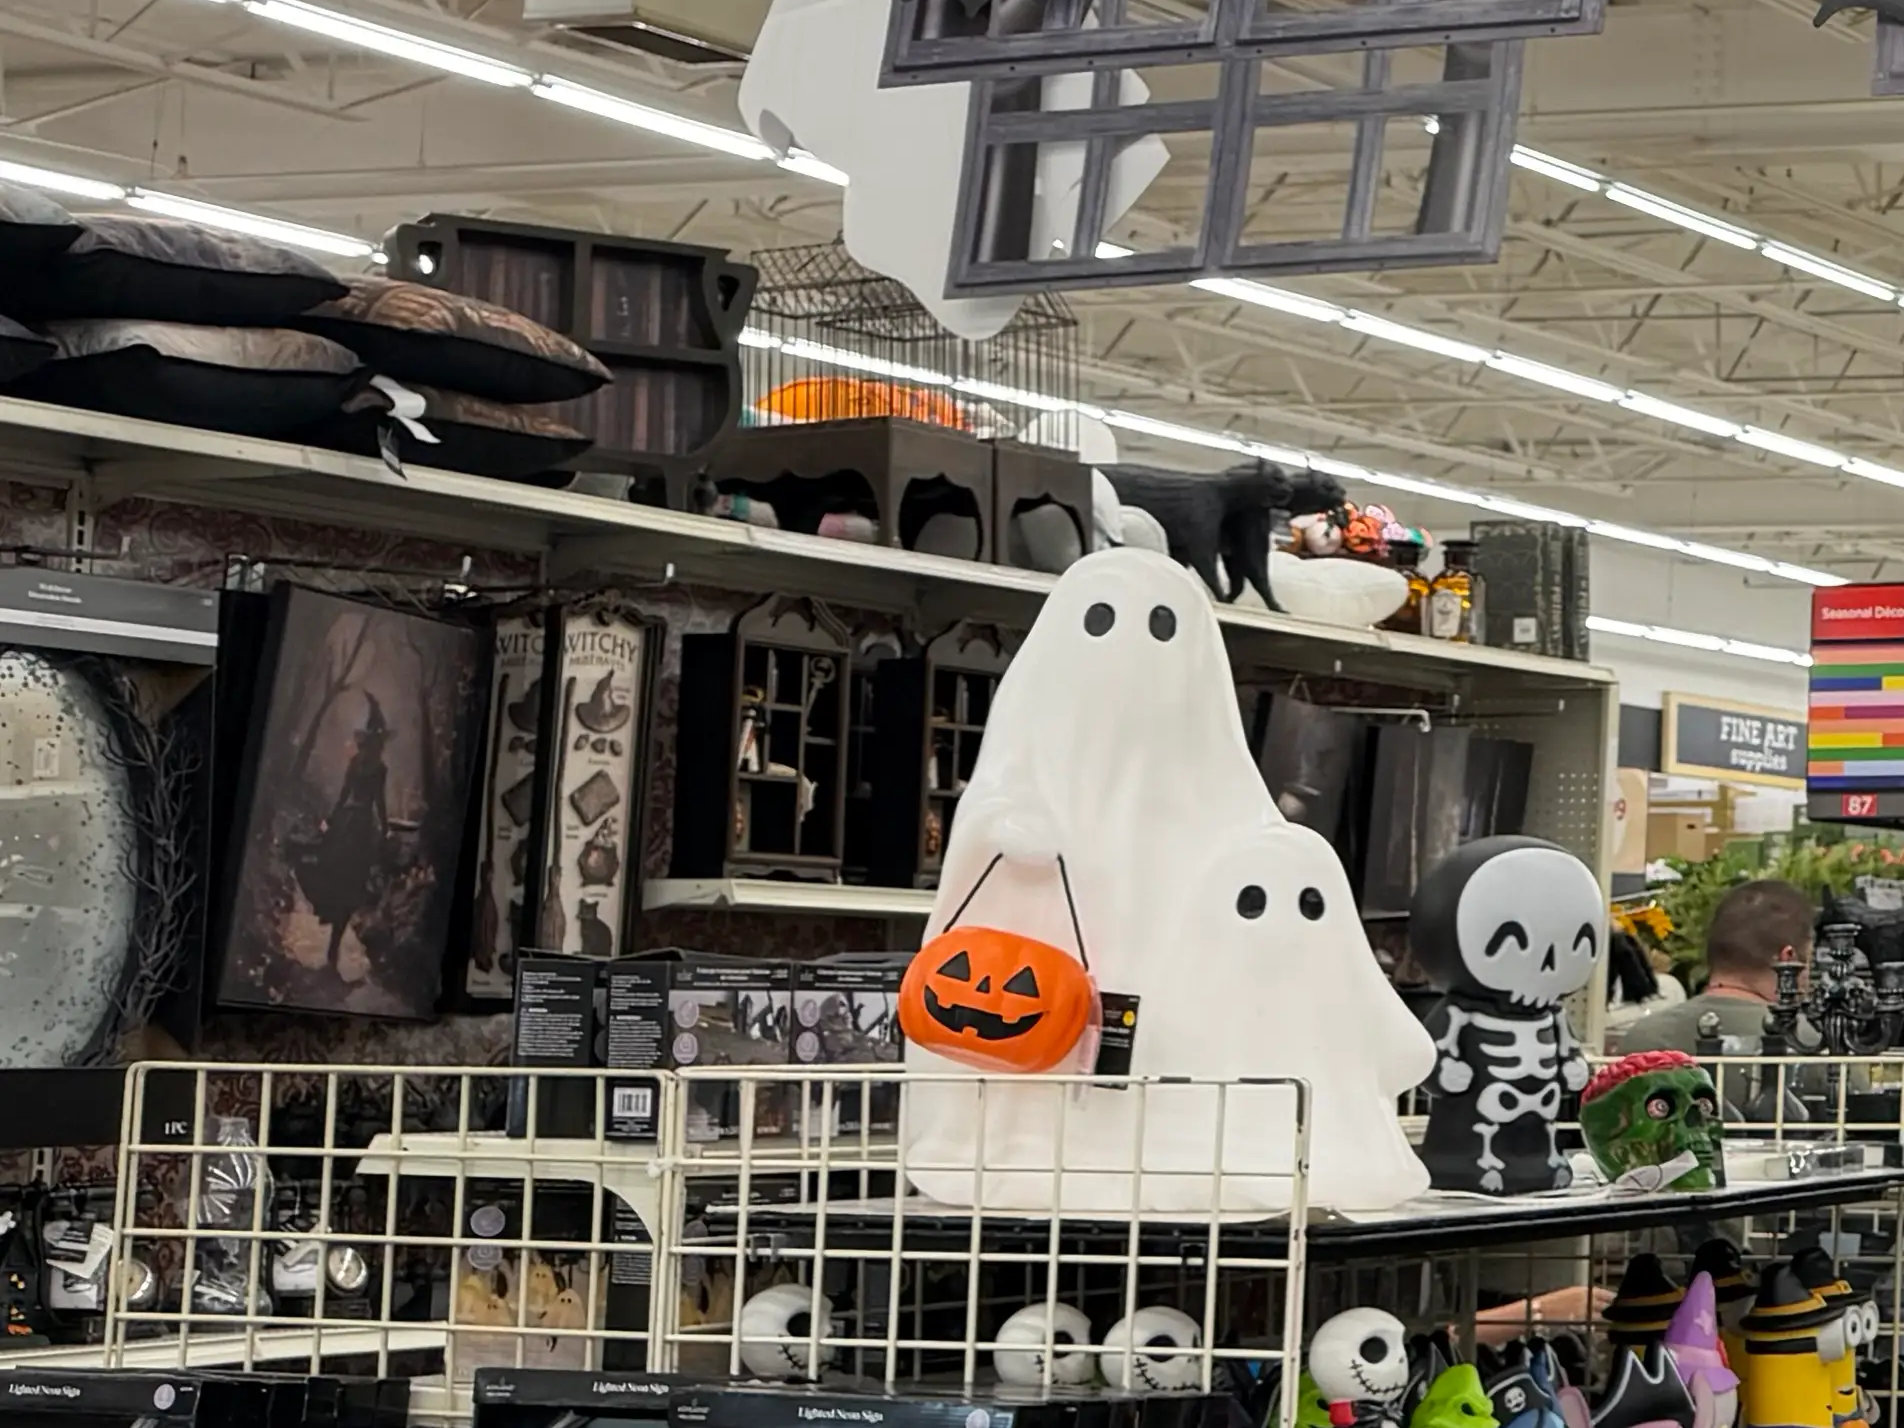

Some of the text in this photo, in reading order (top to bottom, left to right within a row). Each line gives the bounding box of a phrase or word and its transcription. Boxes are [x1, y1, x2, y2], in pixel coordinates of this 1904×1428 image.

[1821, 607, 1873, 620] Seasonal
[564, 632, 637, 663] WITCHY
[1720, 715, 1798, 750] FINE ART
[1731, 748, 1787, 772] supplies
[1848, 797, 1872, 814] 87
[171, 1121, 188, 1135] PC
[798, 1407, 883, 1423] Lighted Neon Sign
